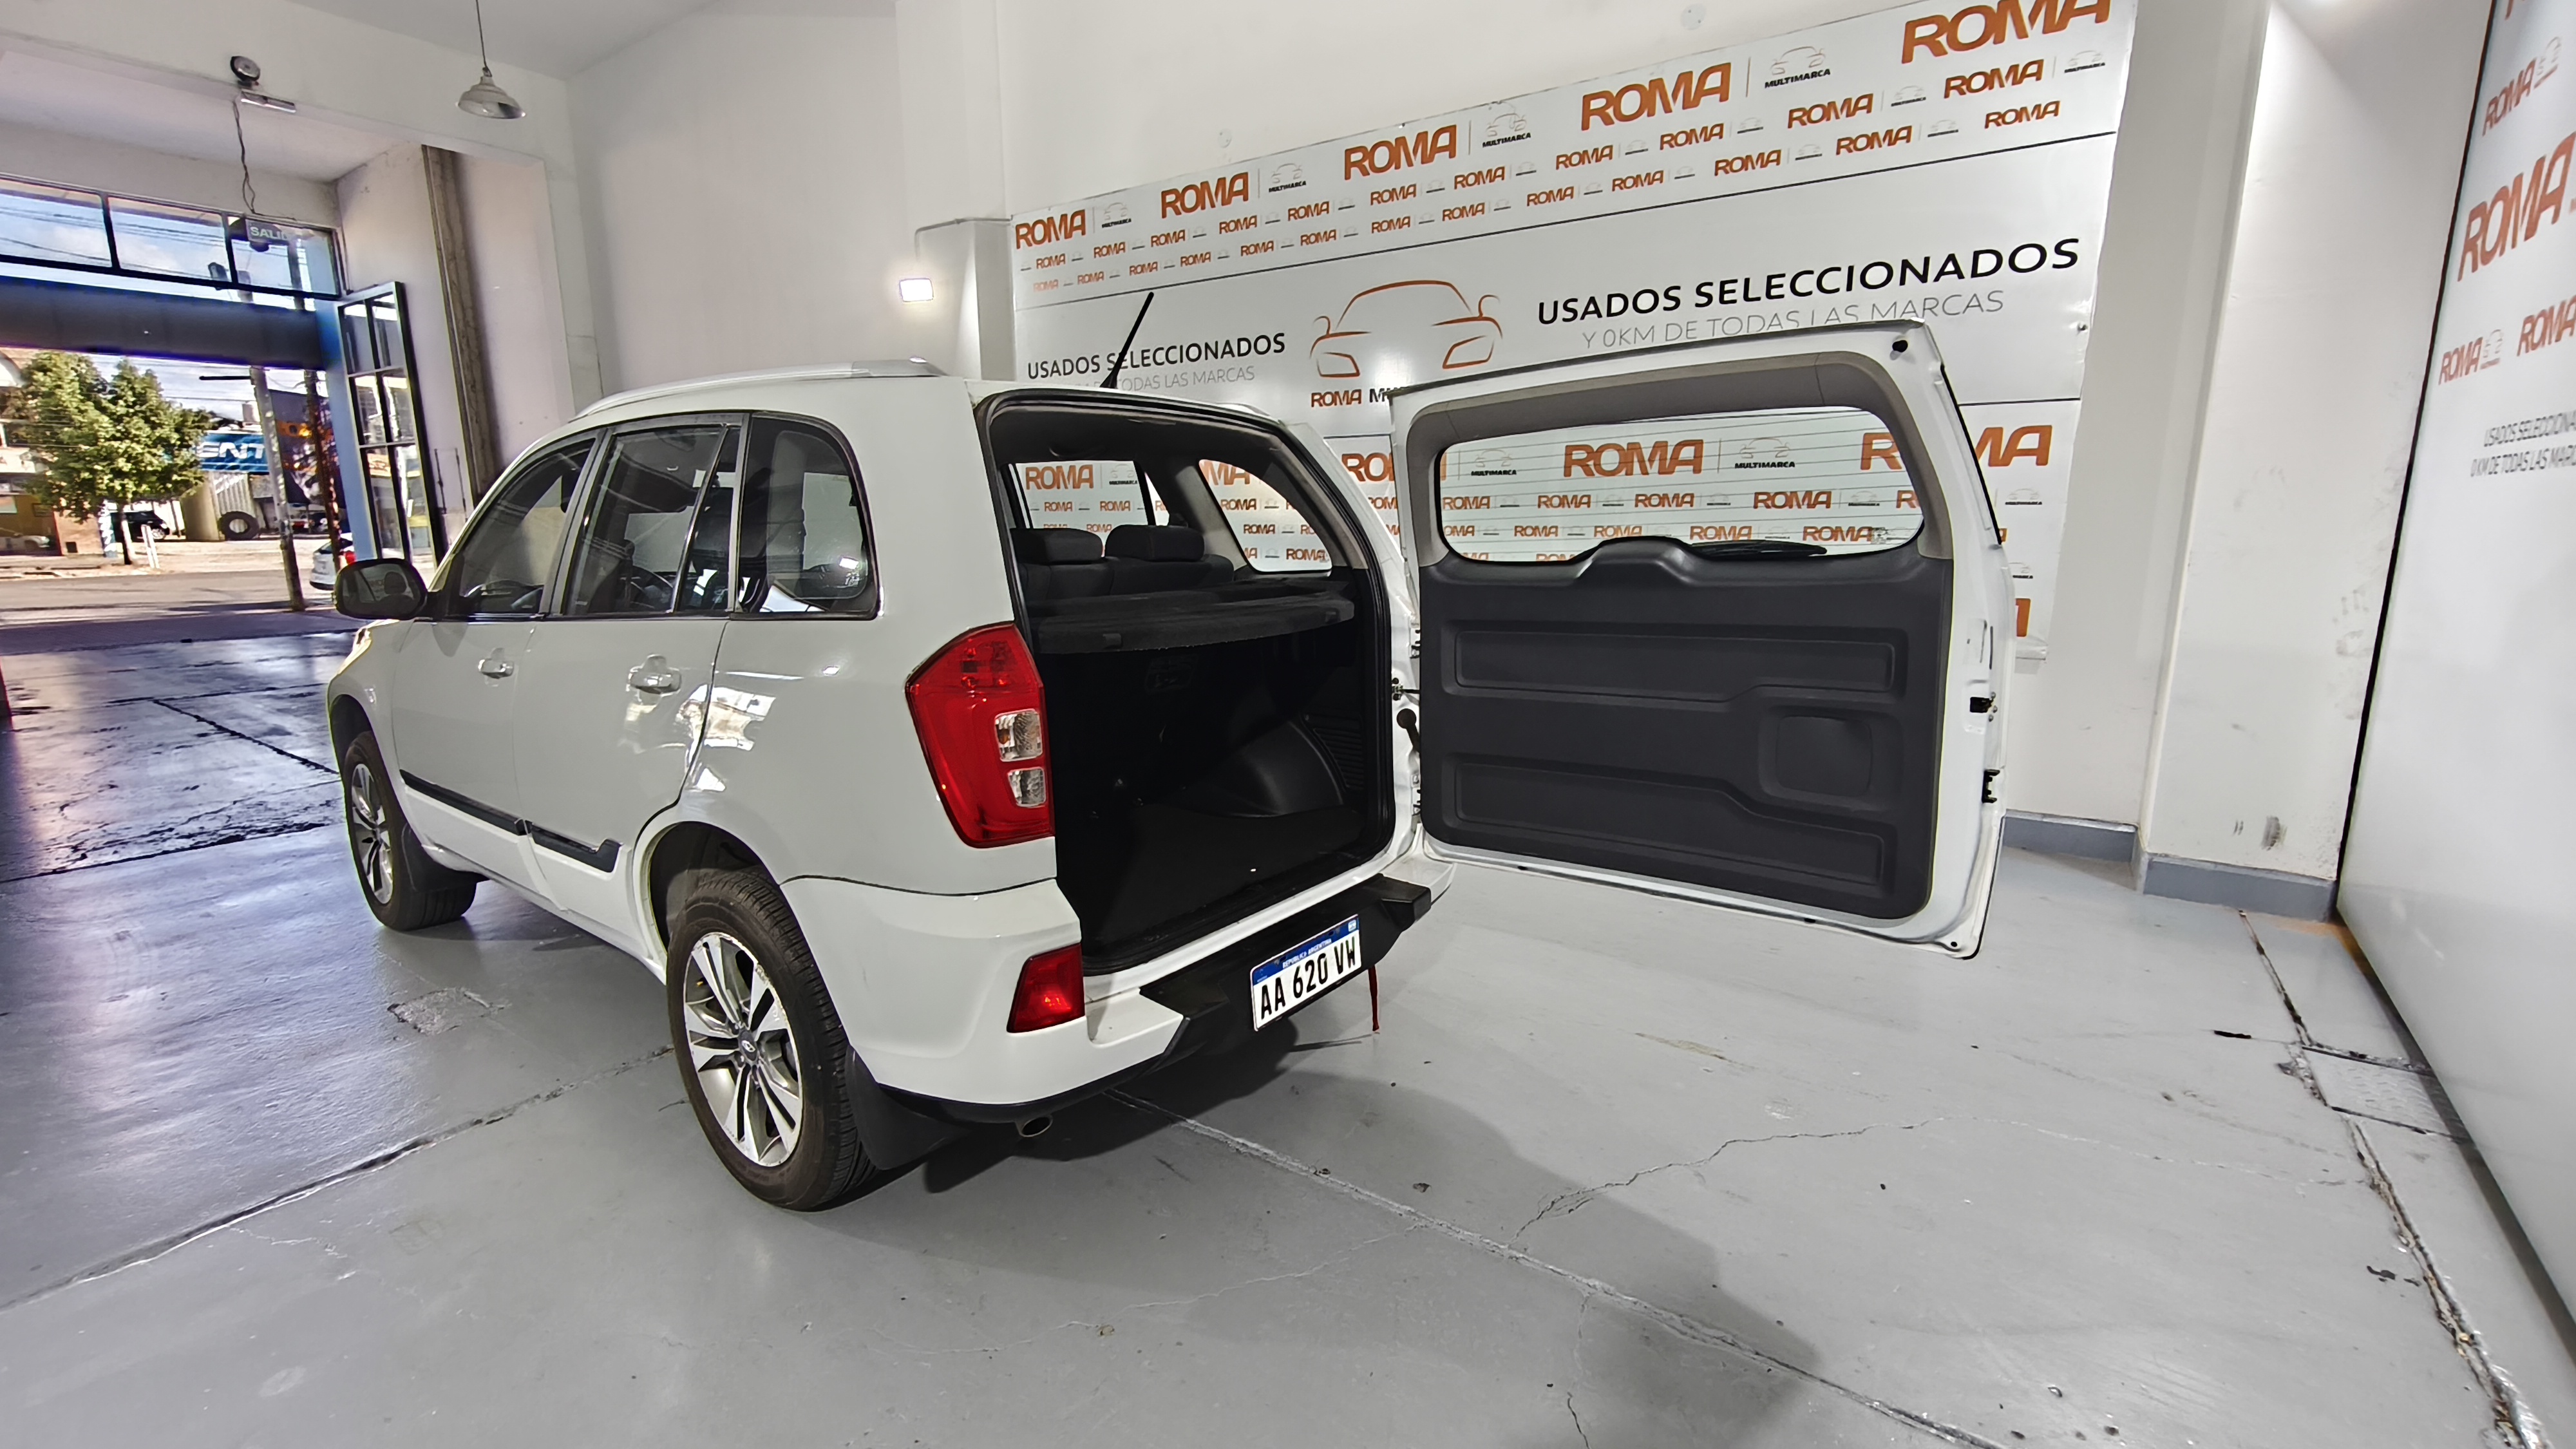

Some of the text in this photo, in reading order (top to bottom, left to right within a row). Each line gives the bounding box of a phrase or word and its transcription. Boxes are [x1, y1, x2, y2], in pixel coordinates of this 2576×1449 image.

[1945, 59, 2045, 99] ROMA
[1581, 62, 1830, 131] ROMA MULTIMARCA
[2483, 57, 2537, 137] ROMA
[1788, 93, 1873, 129] ROMA
[1985, 100, 2060, 129] ROMA
[1660, 123, 1724, 151] ROMA
[1836, 126, 1912, 156] ROMA
[1345, 124, 1531, 181] ROMA MULTIMARCA
[1556, 145, 1613, 170] ROMA
[1715, 150, 1782, 177] ROMA
[1454, 166, 1506, 190] ROMA
[1612, 171, 1664, 192] ROMA
[1160, 173, 1307, 219] ROMA MULTIMARCA
[1370, 185, 1417, 205] ROMA
[1527, 187, 1575, 206] ROMA
[1288, 202, 1330, 220] ROMA
[1443, 203, 1485, 222] ROMA
[2458, 131, 2576, 281] ROMA
[1016, 209, 1086, 249] ROMA
[1219, 216, 1257, 234] ROMA
[1371, 216, 1410, 233] ROMA
[1150, 230, 1186, 247] ROMA
[1300, 230, 1337, 245] ROMA
[1094, 242, 1126, 258] ROMA
[1241, 241, 1274, 256] ROMA
[1036, 254, 1065, 269] ROMA
[1130, 261, 1158, 275] ROMA
[1180, 252, 1211, 267] ROMA
[1078, 272, 1104, 284] ROMA
[1539, 238, 2080, 325] USADOS SELECCIONADOS
[1582, 331, 1597, 349] Y
[1665, 321, 1698, 342] DE
[1707, 310, 1801, 337] TODAS
[1871, 290, 2004, 320] MARCAS
[1028, 354, 1101, 379] USADOS
[2438, 336, 2483, 385] ROMA
[1119, 375, 1161, 392] ODAS
[1164, 372, 1189, 388] LAS
[1193, 365, 1255, 384] MARCAS
[1311, 389, 1362, 407] ROMA
[1975, 425, 2053, 468] MA
[1341, 453, 1395, 482] RO
[1564, 440, 1704, 478] ROMA
[1734, 461, 1795, 469] MULTIMARCA
[1026, 465, 1094, 490] ROMA
[1199, 460, 1250, 486] MA
[1045, 502, 1073, 512] ROMA
[1100, 501, 1130, 511] ROMA
[1220, 499, 1257, 511] ROMA
[1443, 497, 1490, 509] ROMA
[1538, 495, 1591, 509] ROMA
[1634, 493, 1695, 508] ROMA
[1754, 491, 1832, 509] ROMA
[1244, 524, 1276, 535] ROMA
[1444, 526, 1475, 536] OMA
[1514, 526, 1558, 537] ROMA
[1594, 526, 1642, 538] ROMA
[1690, 526, 1752, 541] ROMA
[1803, 526, 1873, 542] ROMA
[1261, 936, 1356, 1020] AA 620 VW
